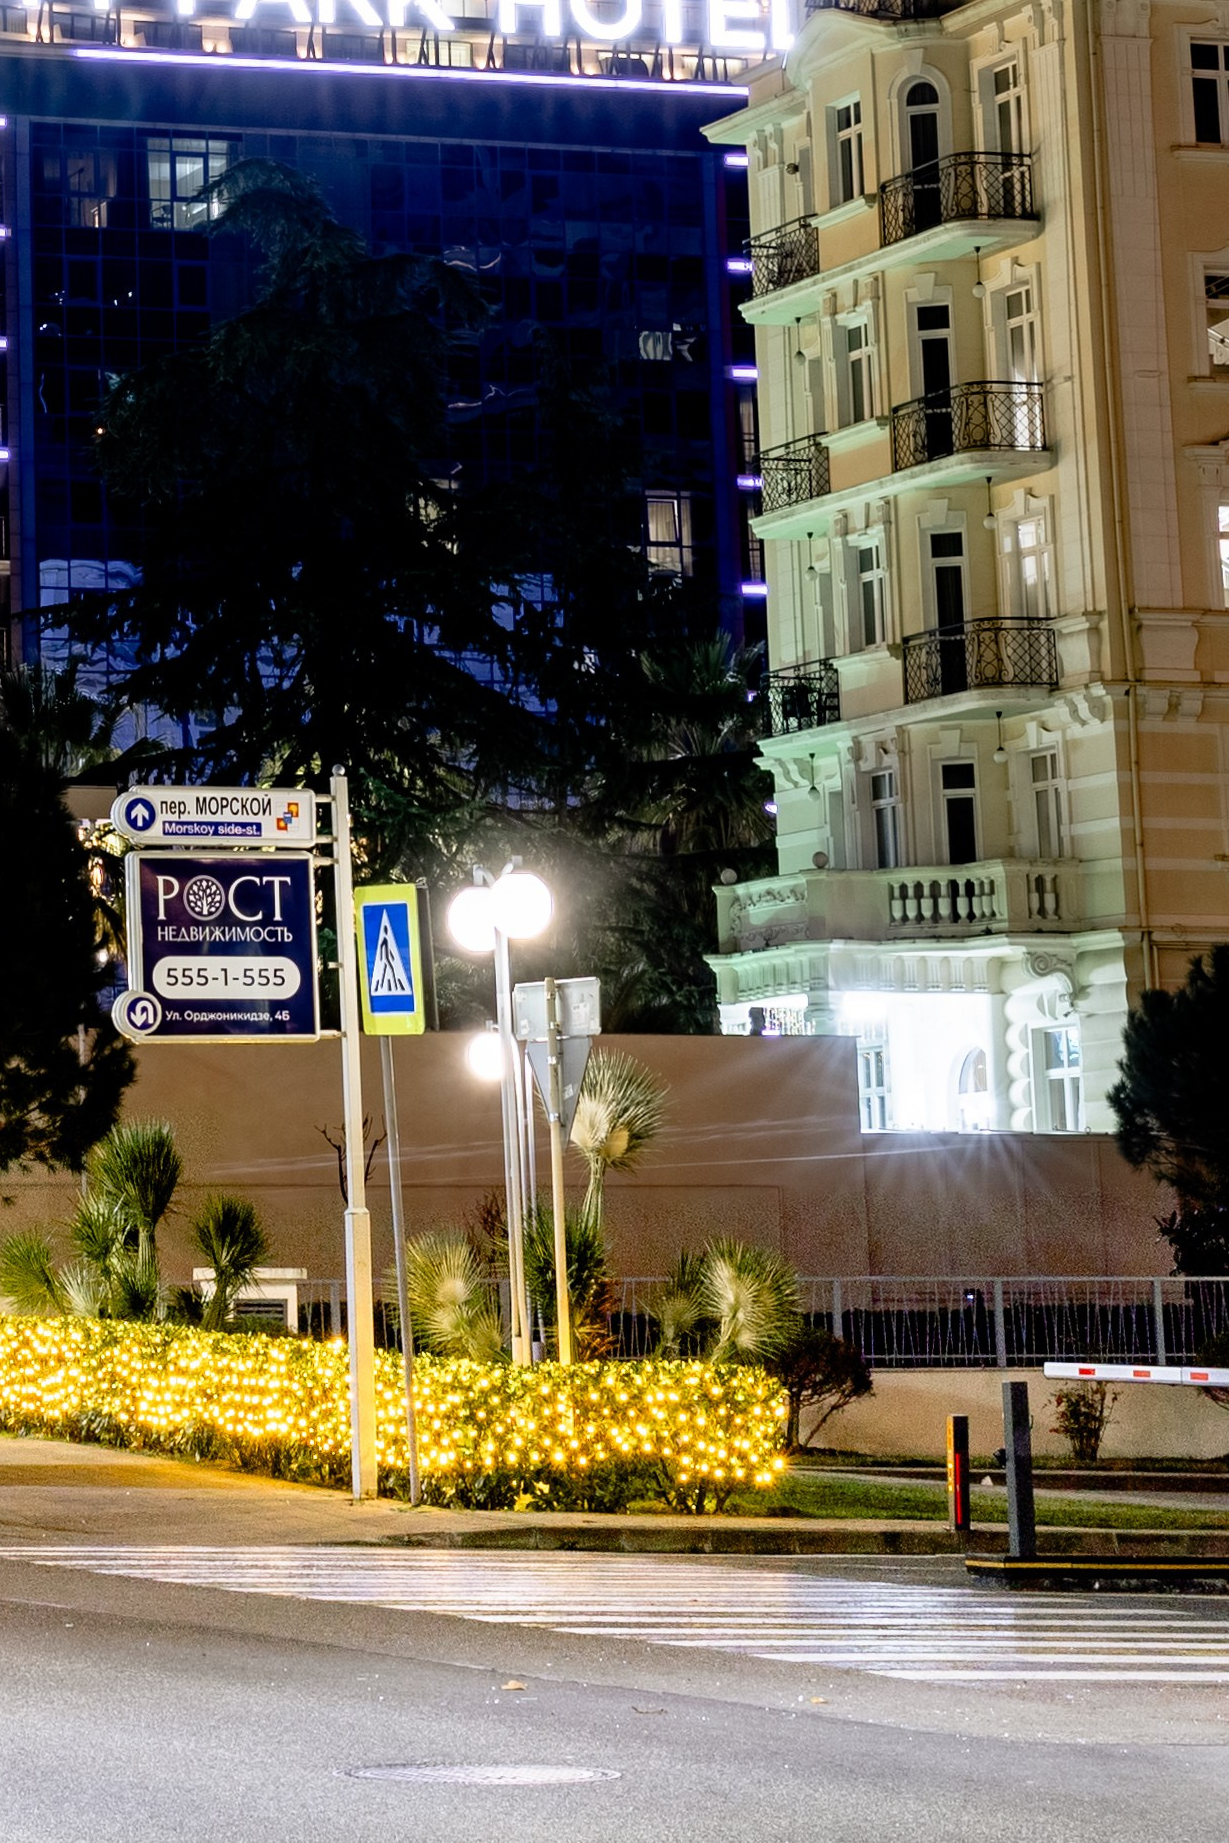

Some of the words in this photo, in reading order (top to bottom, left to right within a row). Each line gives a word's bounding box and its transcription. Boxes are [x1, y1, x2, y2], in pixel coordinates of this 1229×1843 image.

[160, 800, 190, 819] пер.
[195, 794, 272, 816] МОРСКОЙ
[164, 823, 215, 836] Morskoy
[218, 823, 261, 835] side-st.
[156, 875, 292, 921] РОСТ
[157, 926, 293, 943] НЕДВИЖИМОСТЬ
[166, 968, 286, 987] 555-1-555
[165, 1010, 182, 1021] Ул.
[184, 1010, 273, 1023] Орджоникидзе,
[274, 1010, 290, 1020] 4Б
